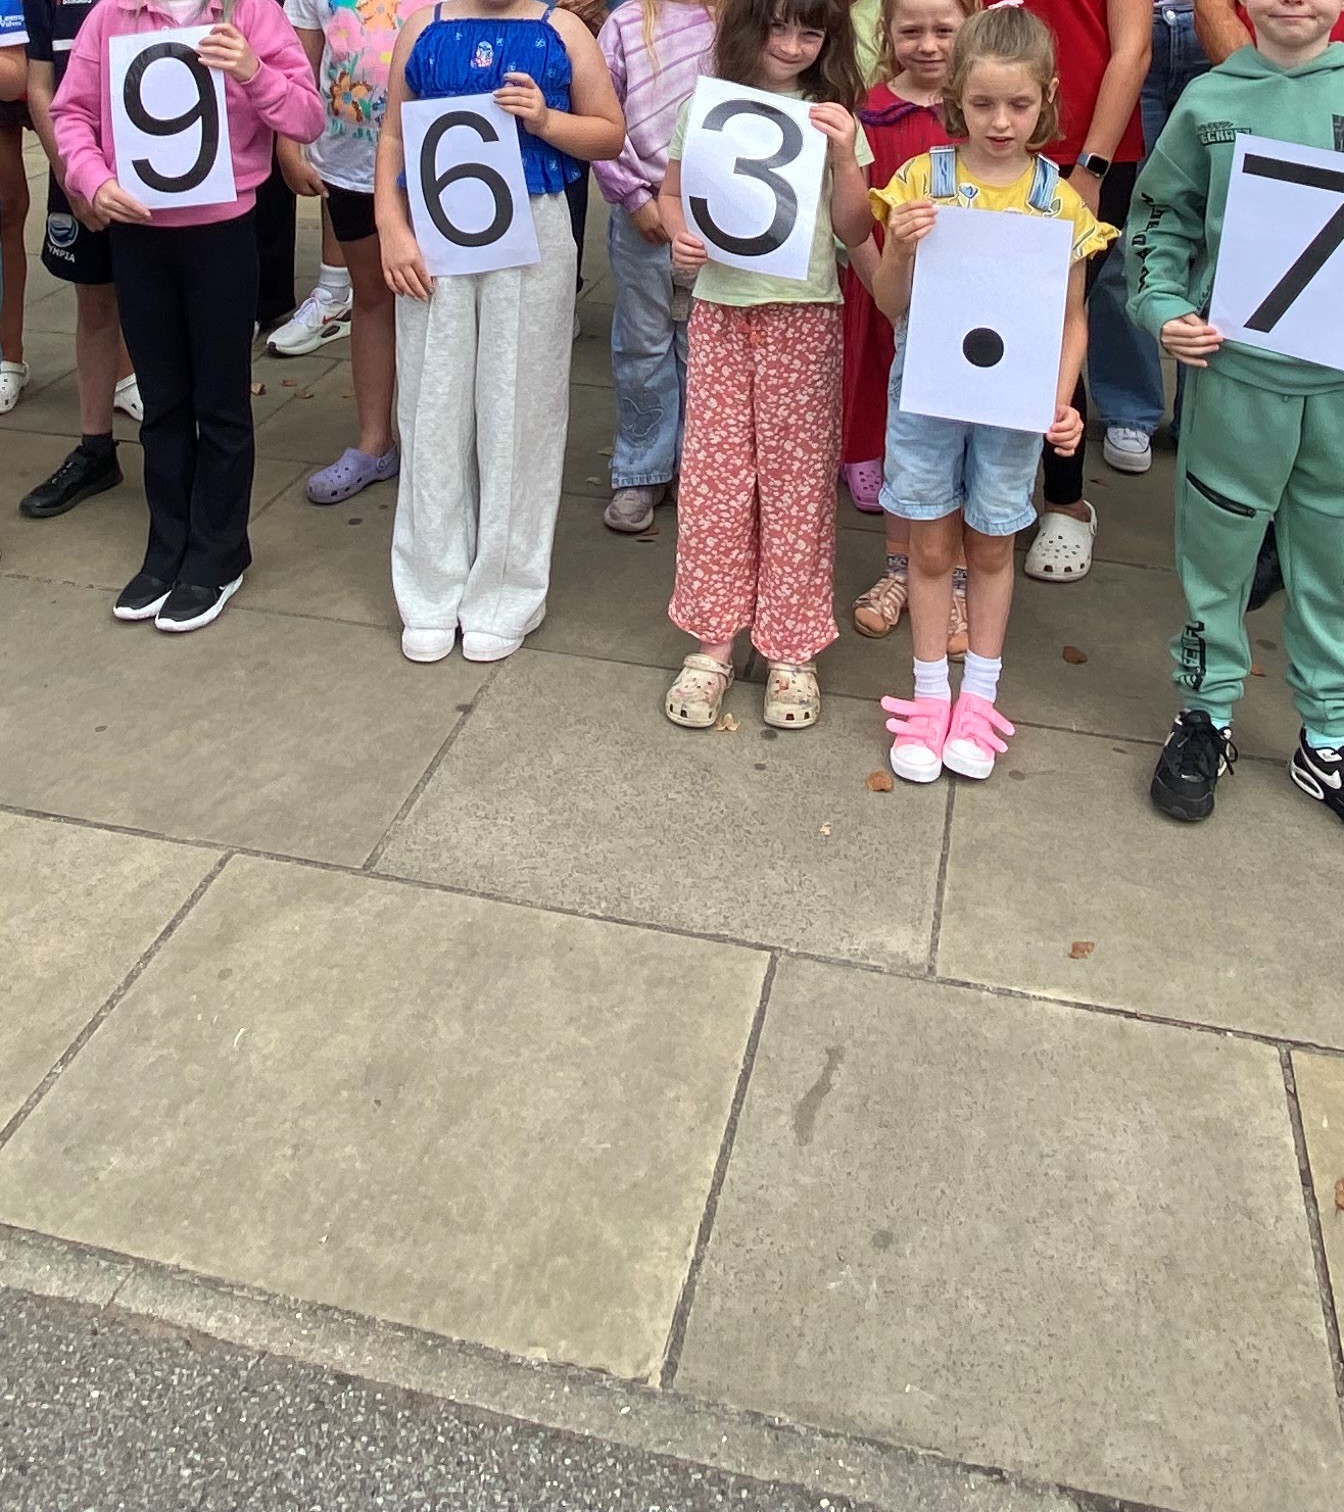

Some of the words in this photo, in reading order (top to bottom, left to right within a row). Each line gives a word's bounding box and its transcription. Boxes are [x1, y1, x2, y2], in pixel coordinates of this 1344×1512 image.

[123, 42, 219, 194] 9
[418, 110, 515, 248] 6
[687, 99, 804, 257] 3
